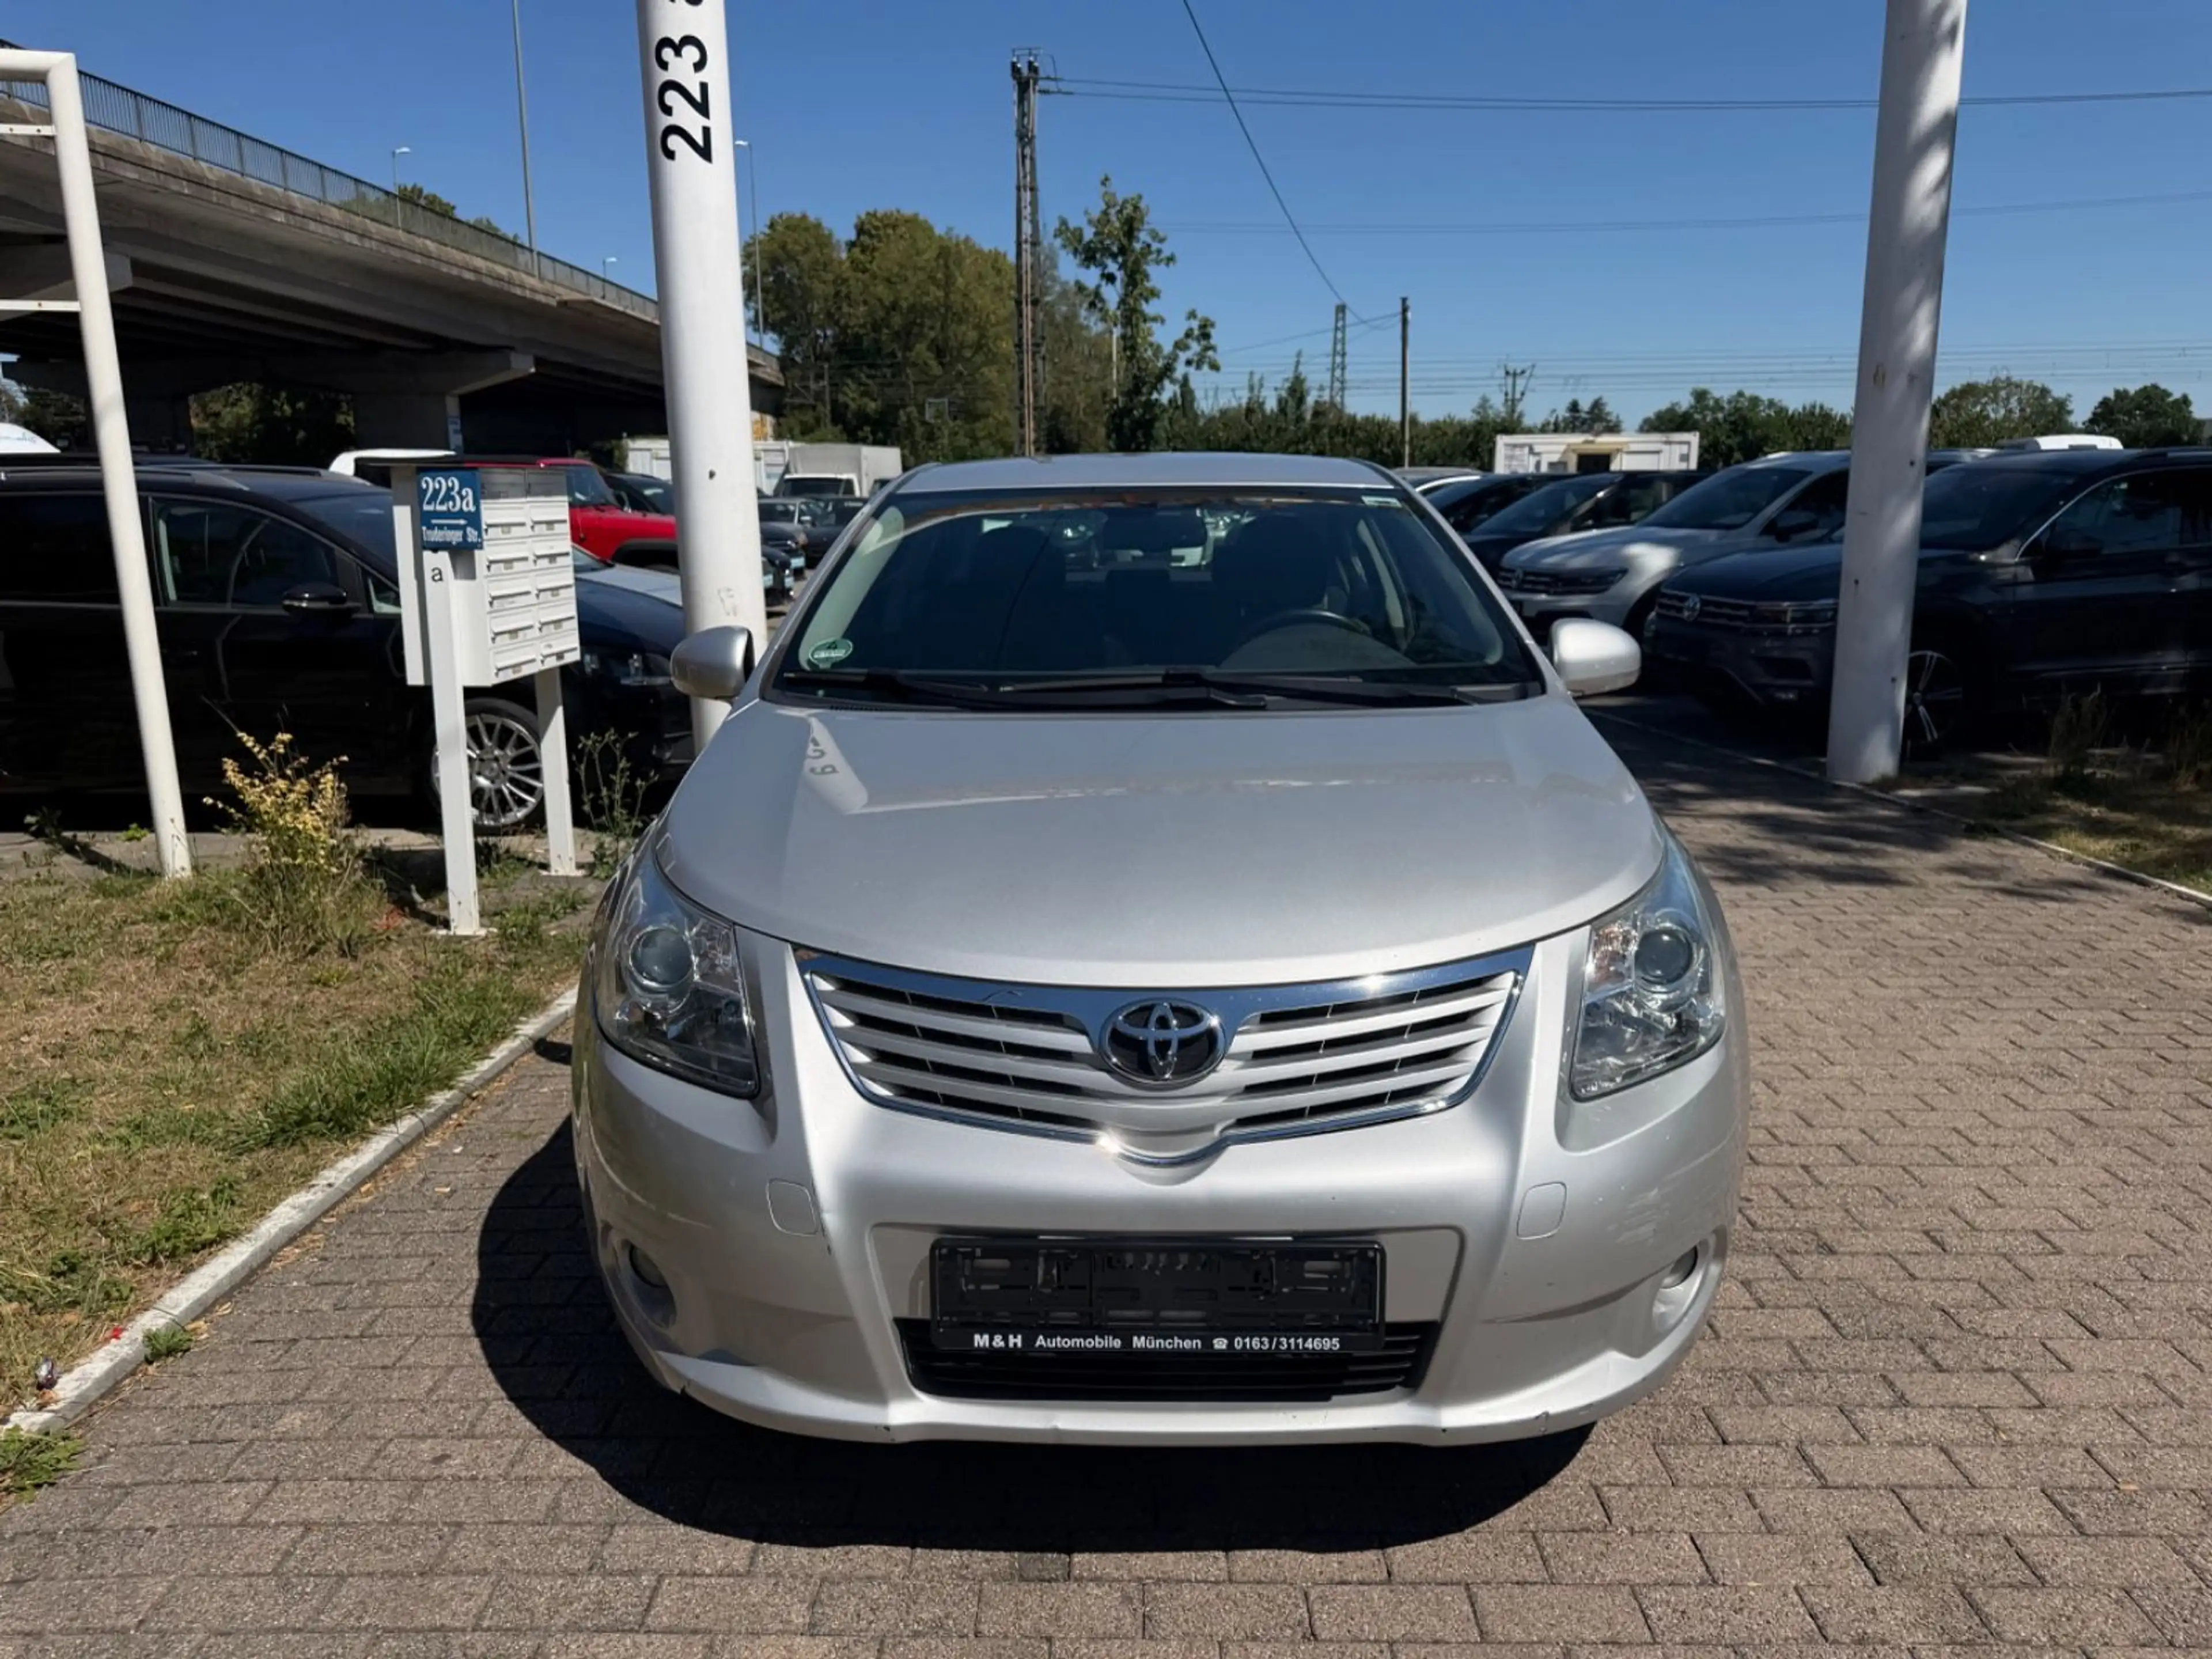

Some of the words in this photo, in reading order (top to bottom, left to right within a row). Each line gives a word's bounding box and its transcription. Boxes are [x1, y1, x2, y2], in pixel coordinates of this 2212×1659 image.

[655, 35, 712, 164] 223
[422, 476, 476, 512] 223a
[431, 567, 443, 582] a
[1035, 1335, 1122, 1349] Automobile
[1132, 1336, 1202, 1350] München
